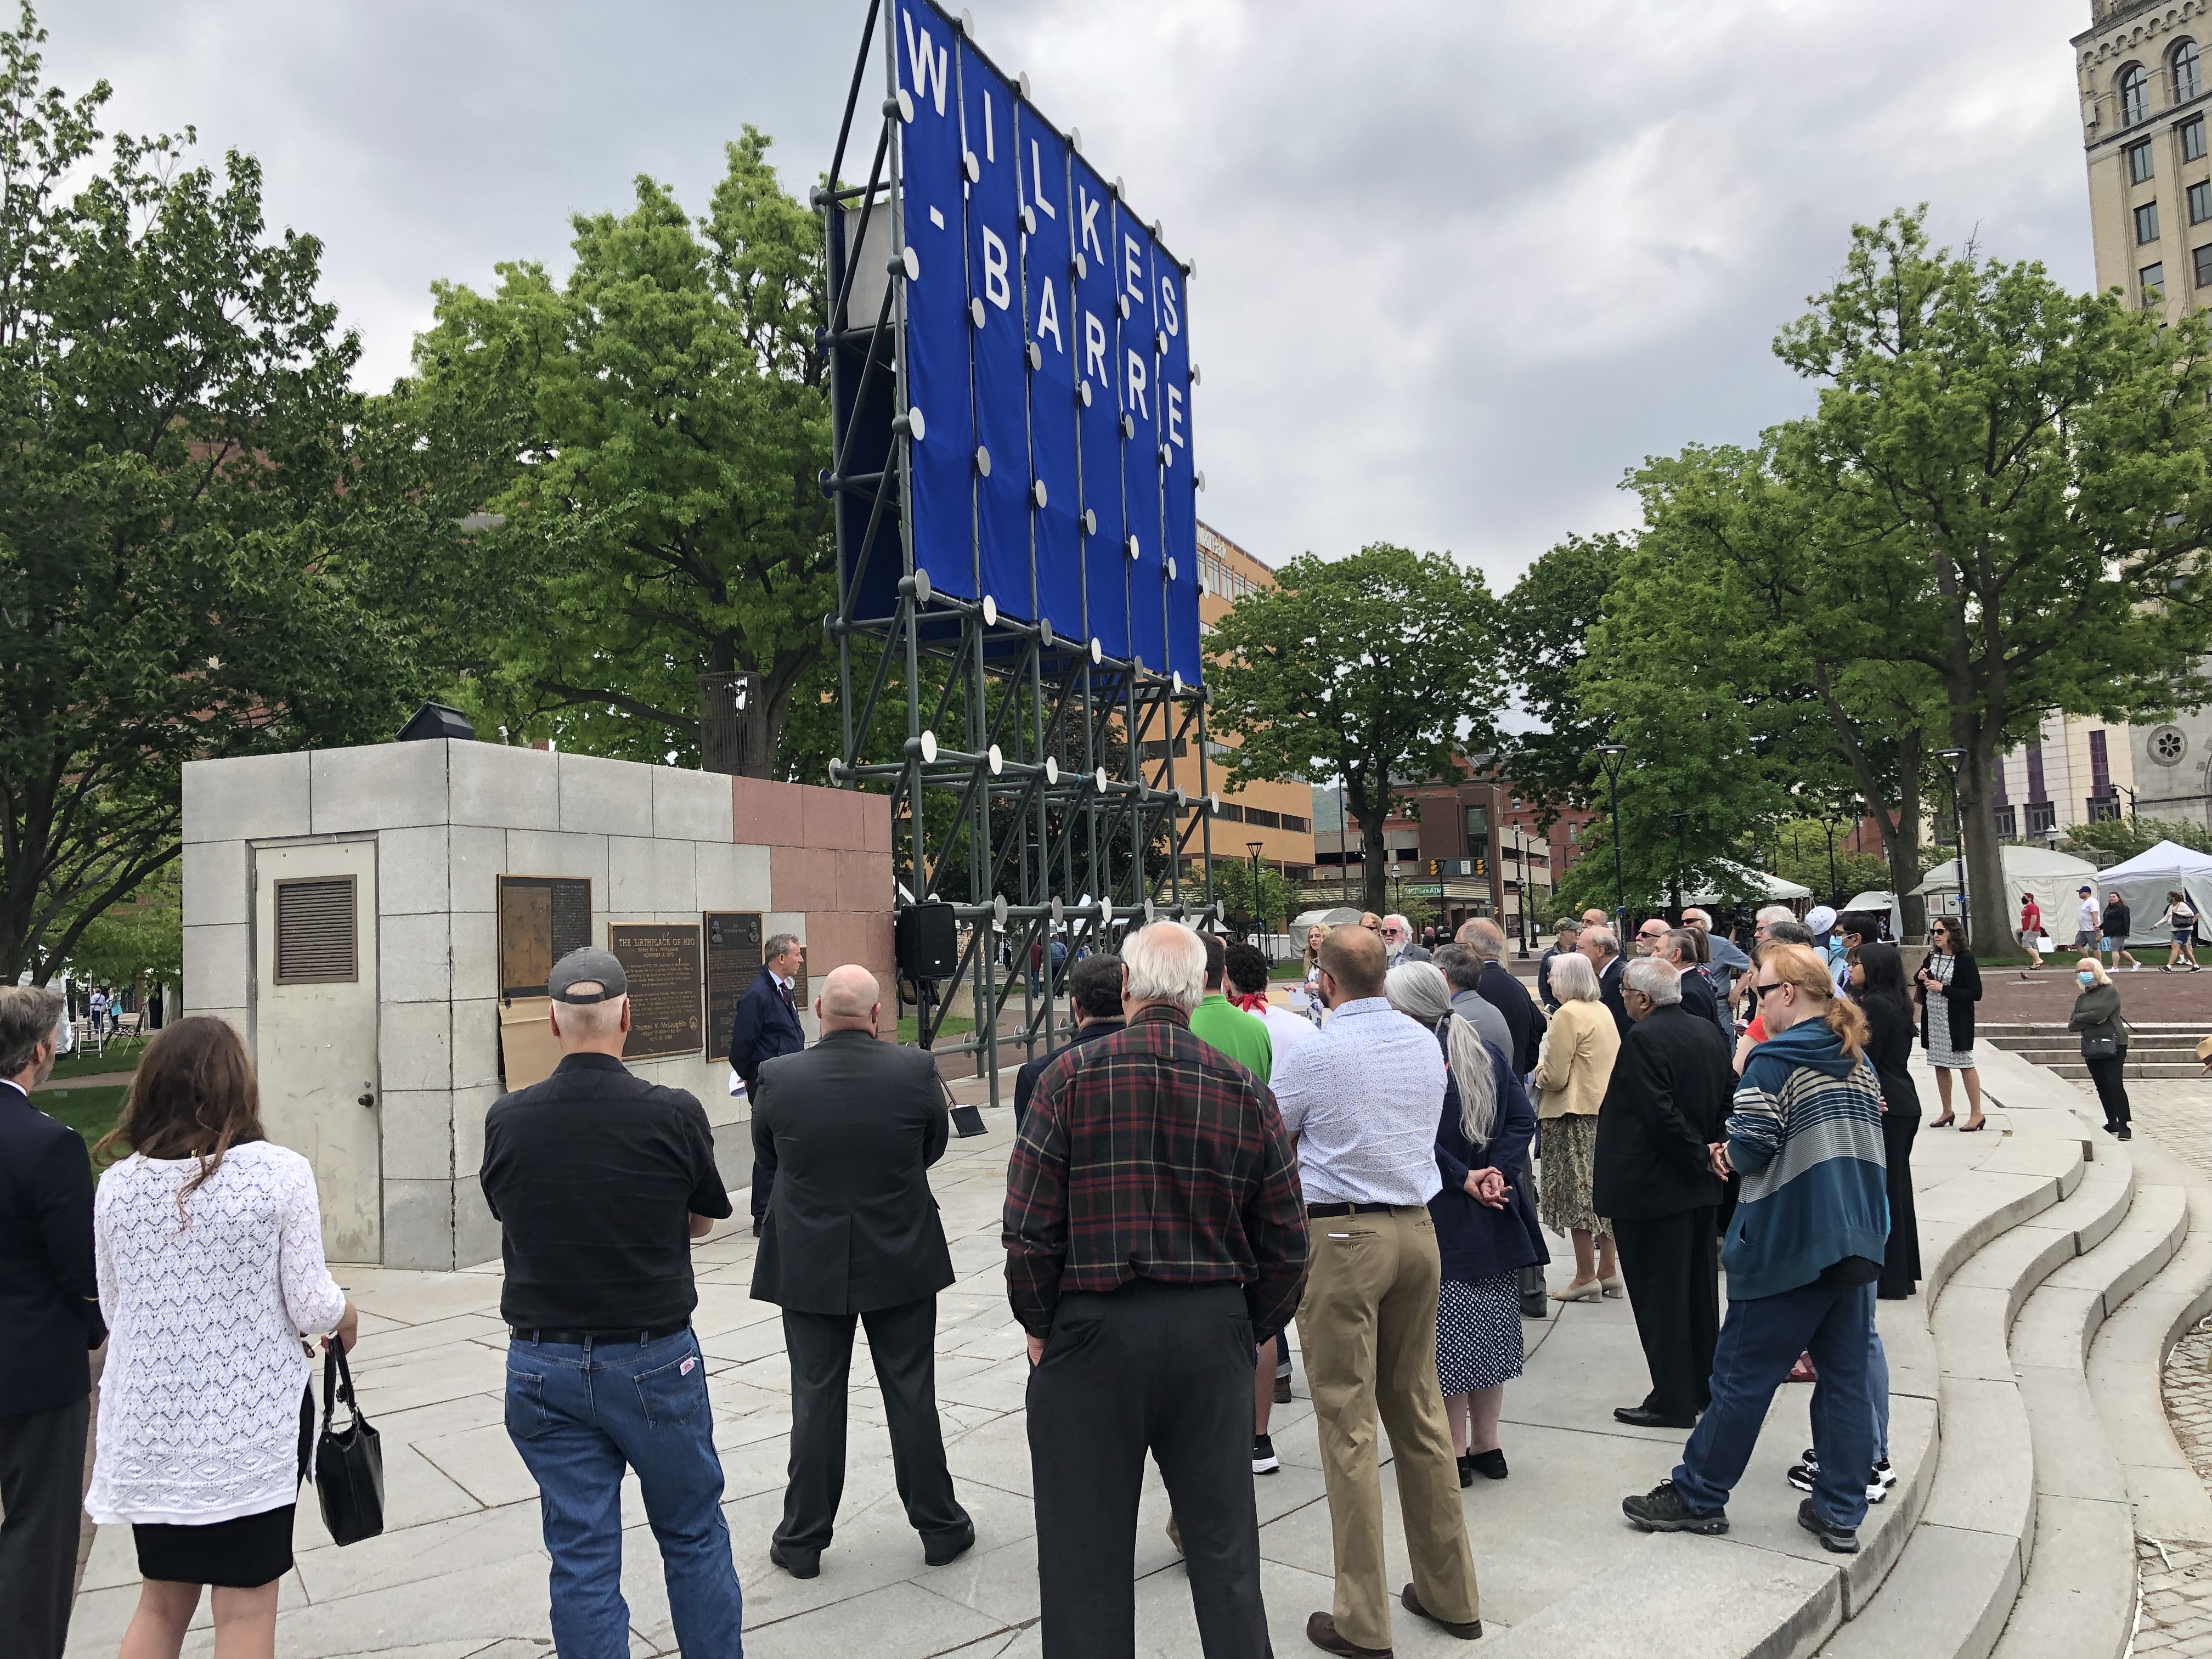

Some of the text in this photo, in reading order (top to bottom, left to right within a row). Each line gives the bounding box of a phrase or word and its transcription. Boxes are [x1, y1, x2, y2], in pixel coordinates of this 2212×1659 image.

[903, 8, 1178, 336] WILKES
[619, 939, 631, 947] THE
[634, 938, 670, 946] BIRTHPLACE
[683, 938, 695, 946] HBO
